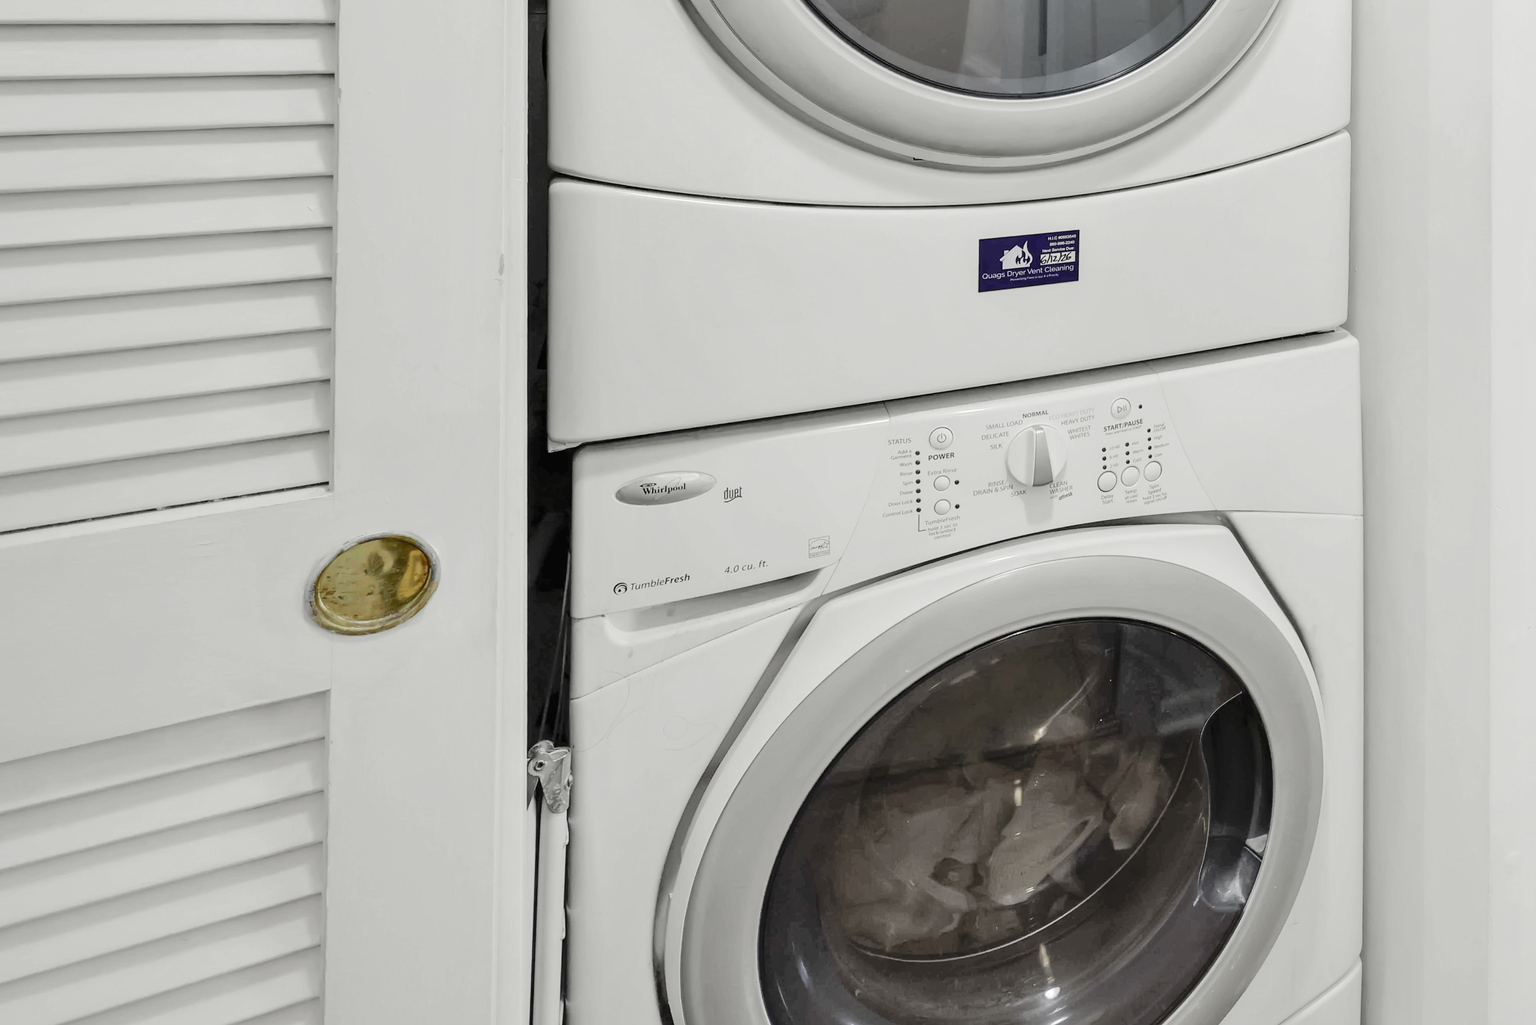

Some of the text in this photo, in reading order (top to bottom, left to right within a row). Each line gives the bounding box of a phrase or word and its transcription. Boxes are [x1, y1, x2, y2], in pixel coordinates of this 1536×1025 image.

[982, 272, 1006, 280] Quags
[1007, 269, 1026, 278] Dryer
[1027, 266, 1043, 275] Vent
[1044, 263, 1074, 274] Cleaning
[1022, 409, 1049, 419] NORMAL
[1080, 407, 1095, 415] DUTY
[985, 419, 1023, 431] SMALL LOAD
[1060, 414, 1096, 426] HEAVY DUTY
[1103, 418, 1143, 432] START/PAUSE
[1067, 425, 1091, 435] WHITEST
[1069, 431, 1090, 440] WHITES
[887, 437, 911, 445] STATUS
[981, 431, 1009, 441] DELICATE
[928, 452, 955, 461] POWER
[642, 483, 687, 496] Whirlpool
[723, 486, 743, 504] duet
[973, 487, 993, 497] DRAIN
[1000, 484, 1014, 492] SPIN
[1010, 489, 1027, 498] SOAK
[925, 515, 961, 526] TumbleFresh
[724, 559, 769, 575] 4.0 cu. ft.
[630, 573, 691, 591] TumbleFresh
